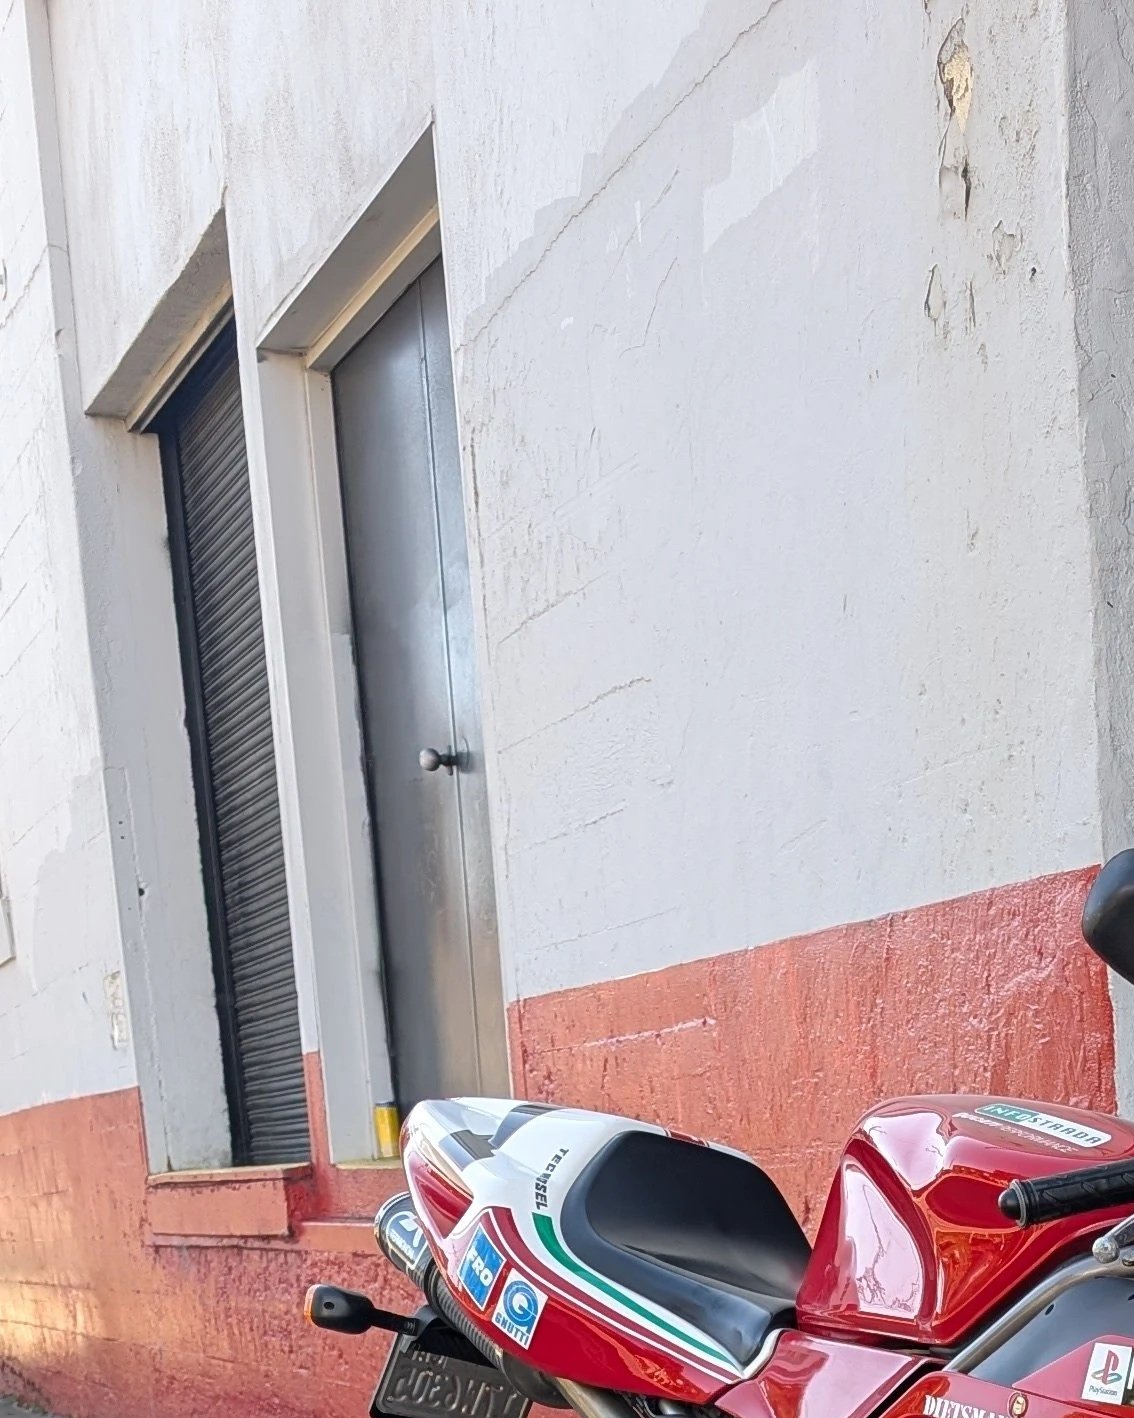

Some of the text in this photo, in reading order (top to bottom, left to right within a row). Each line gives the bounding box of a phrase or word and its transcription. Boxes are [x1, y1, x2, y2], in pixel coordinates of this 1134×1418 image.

[983, 1104, 1103, 1145] INFOSTRADA
[466, 1245, 494, 1287] FRO
[494, 1311, 531, 1347] GNUTTI
[1088, 1384, 1119, 1398] PlayStation
